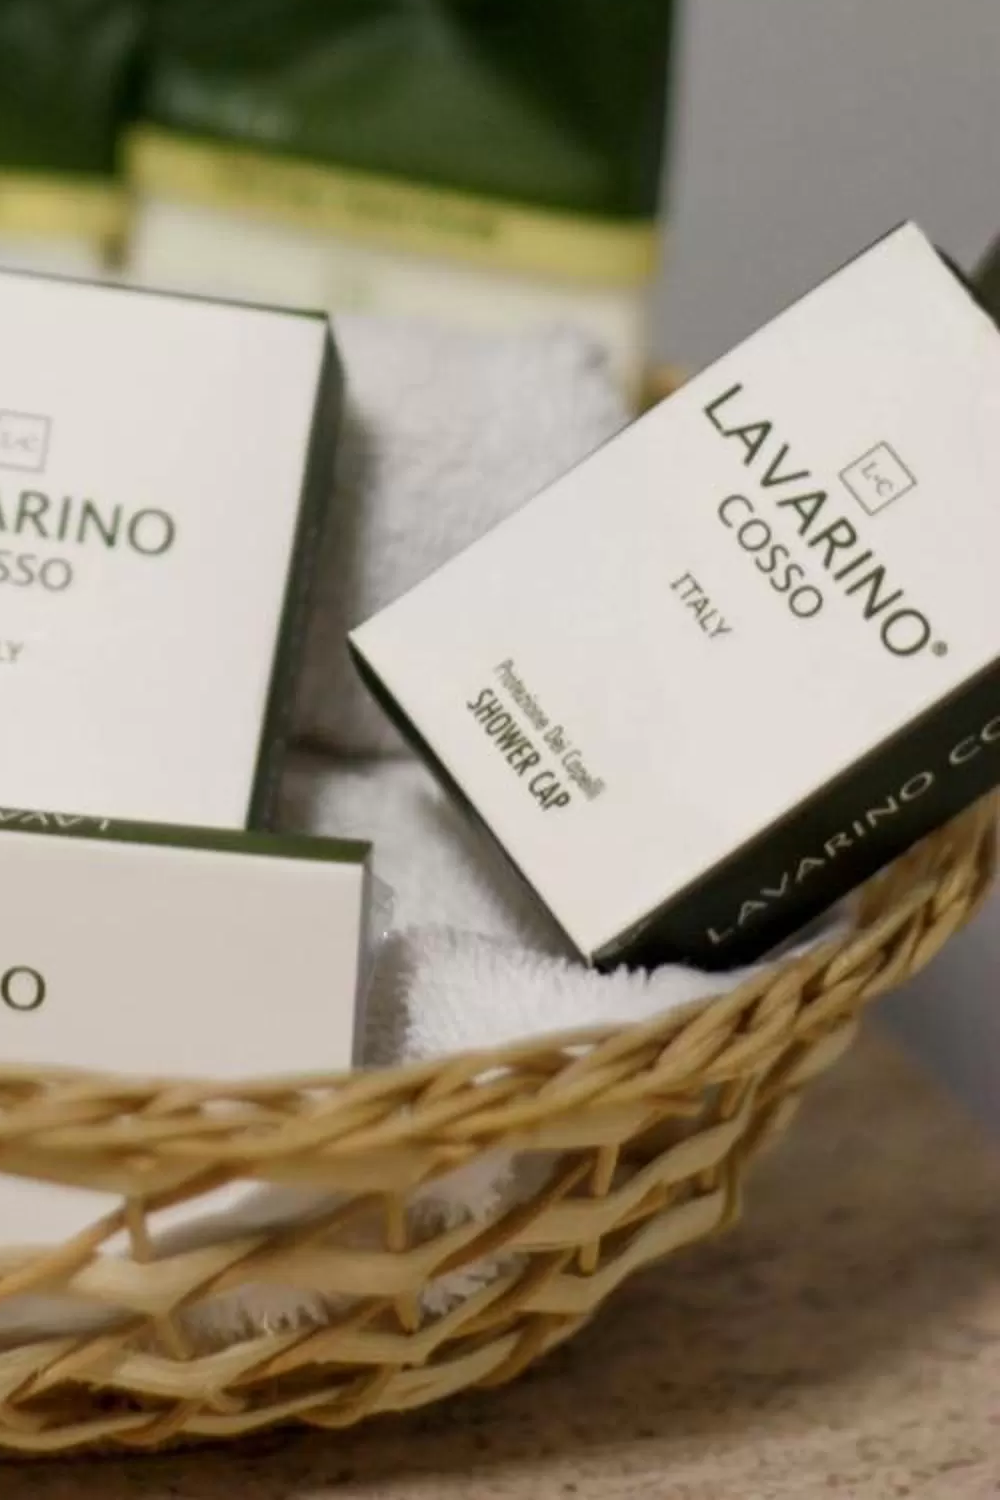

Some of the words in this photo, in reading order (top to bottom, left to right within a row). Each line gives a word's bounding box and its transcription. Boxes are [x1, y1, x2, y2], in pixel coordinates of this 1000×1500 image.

[670, 571, 734, 642] ITALY
[716, 493, 824, 621] COSSO
[466, 687, 541, 778] SHOWER
[528, 771, 571, 812] CAP
[706, 771, 935, 945] LAVARINO
